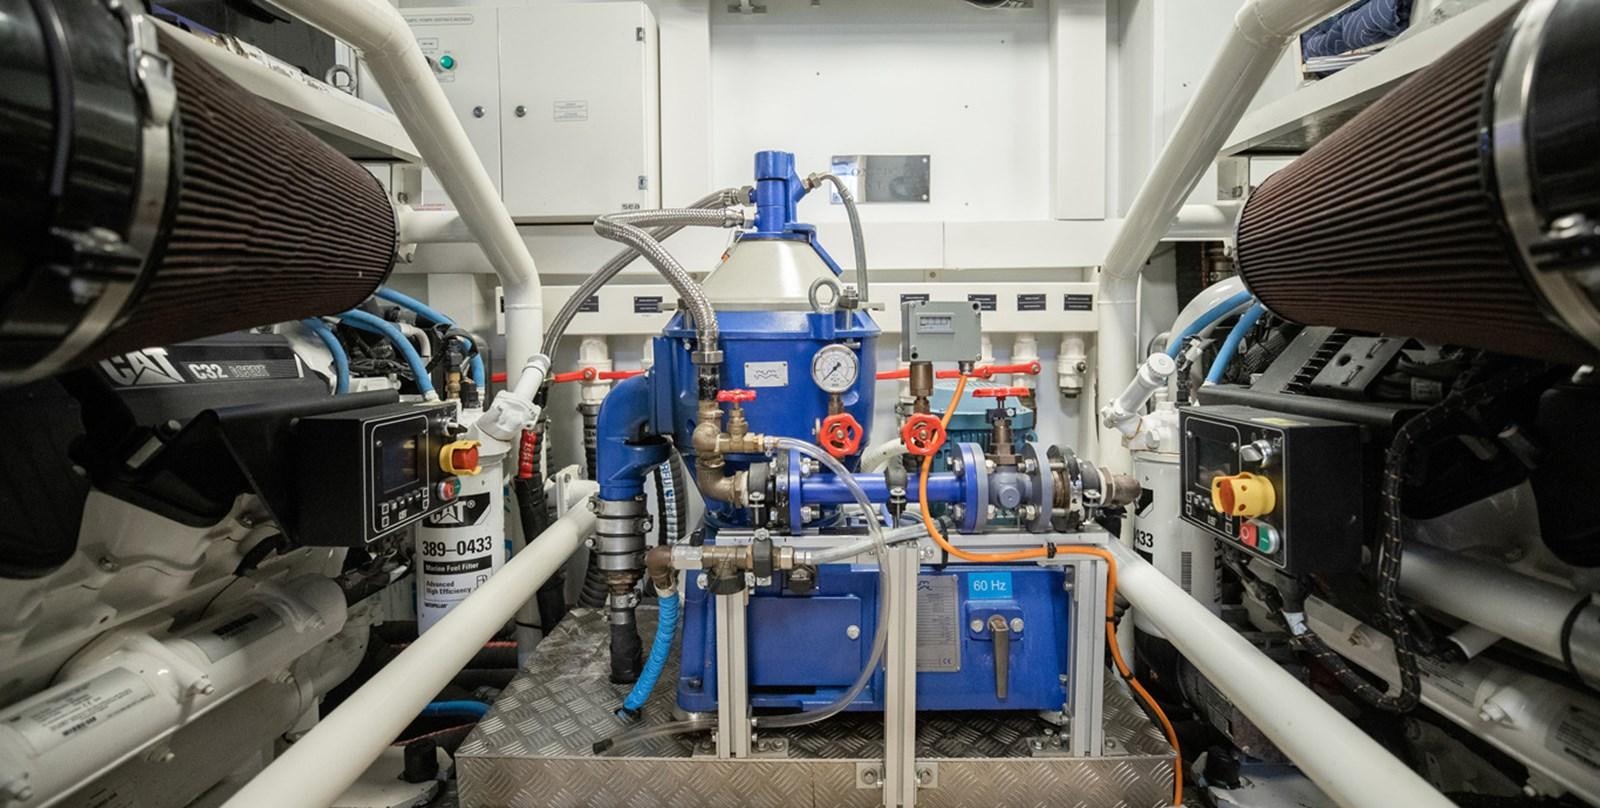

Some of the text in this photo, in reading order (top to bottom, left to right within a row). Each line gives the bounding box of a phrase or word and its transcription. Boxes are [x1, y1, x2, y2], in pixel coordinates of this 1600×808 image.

[98, 347, 186, 386] CAT
[188, 363, 228, 380] C32
[429, 500, 467, 524] CAT
[422, 536, 492, 557] 389-0433
[425, 562, 480, 572] Marine Fuel Filter
[426, 580, 455, 588] Advanced
[426, 587, 472, 595] High Efficiency
[973, 579, 1007, 591] 60 Hz
